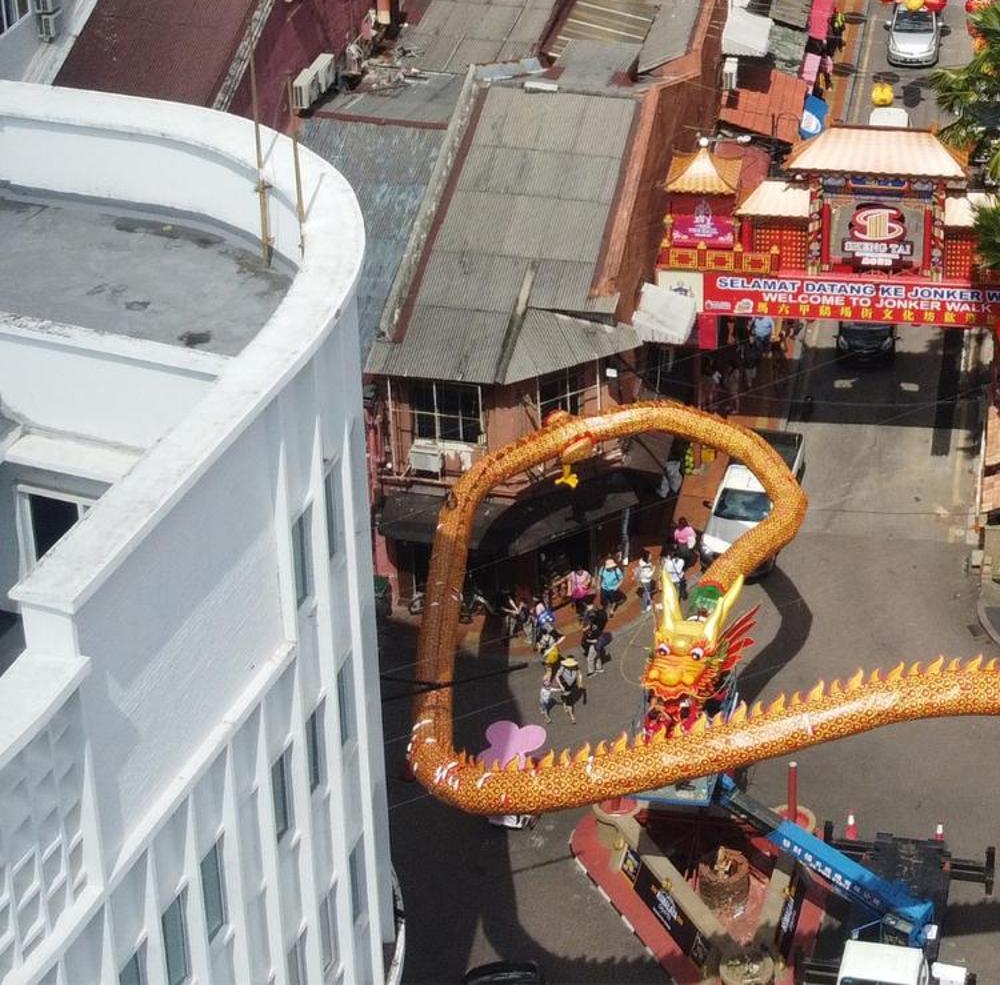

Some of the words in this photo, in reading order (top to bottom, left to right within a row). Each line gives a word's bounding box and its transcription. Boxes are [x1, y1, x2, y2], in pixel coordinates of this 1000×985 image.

[717, 276, 800, 292] SELAMAT
[805, 281, 876, 297] DATANG
[880, 284, 905, 298] KE
[909, 286, 983, 302] JONKER
[762, 292, 845, 307] WELCOME
[849, 296, 872, 308] TO
[875, 298, 942, 312] JONKER
[945, 301, 992, 314] WALK
